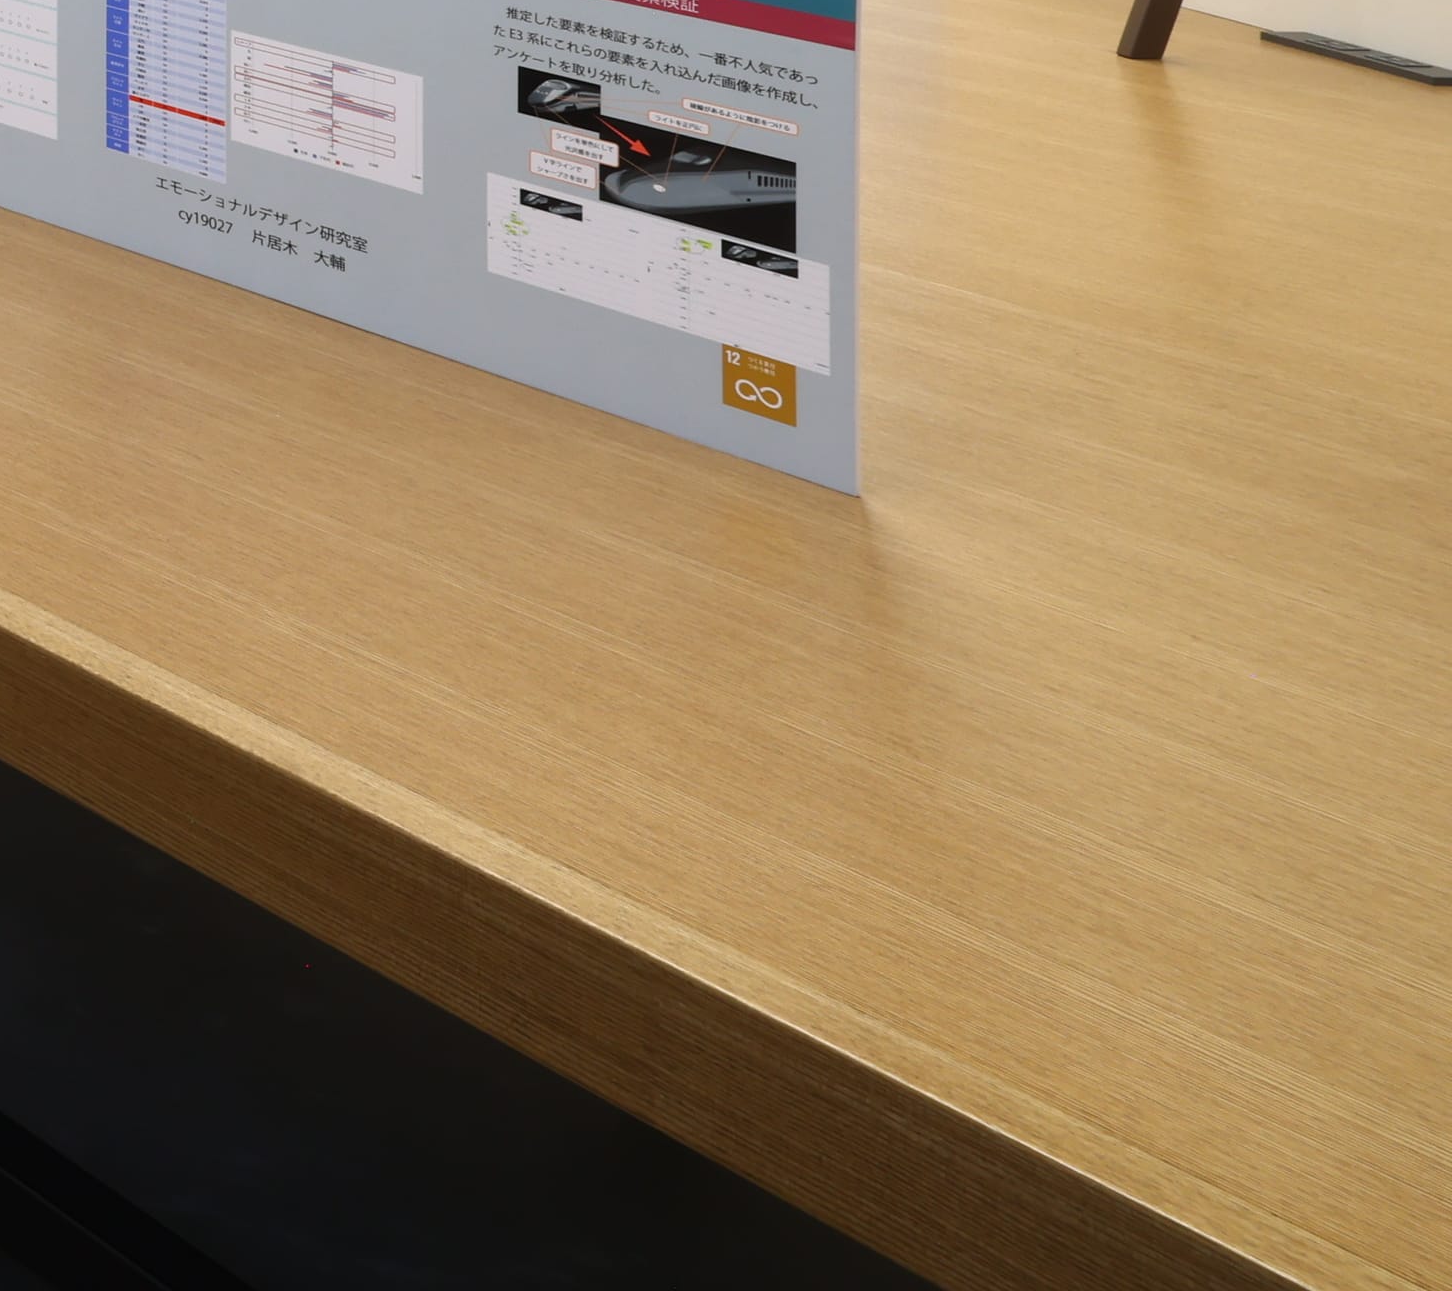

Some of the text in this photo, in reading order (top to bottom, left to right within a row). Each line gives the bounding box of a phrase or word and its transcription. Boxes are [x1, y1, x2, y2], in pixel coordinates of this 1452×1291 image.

[493, 44, 662, 96] アンケートを取り分析した。
[506, 6, 819, 87] 推定した要素を検証するため、一番不人気であっ
[155, 174, 369, 254] エモーショナルデザイン研究室
[177, 206, 347, 274] cy19027 片居木 大輔
[725, 350, 741, 366] 12
